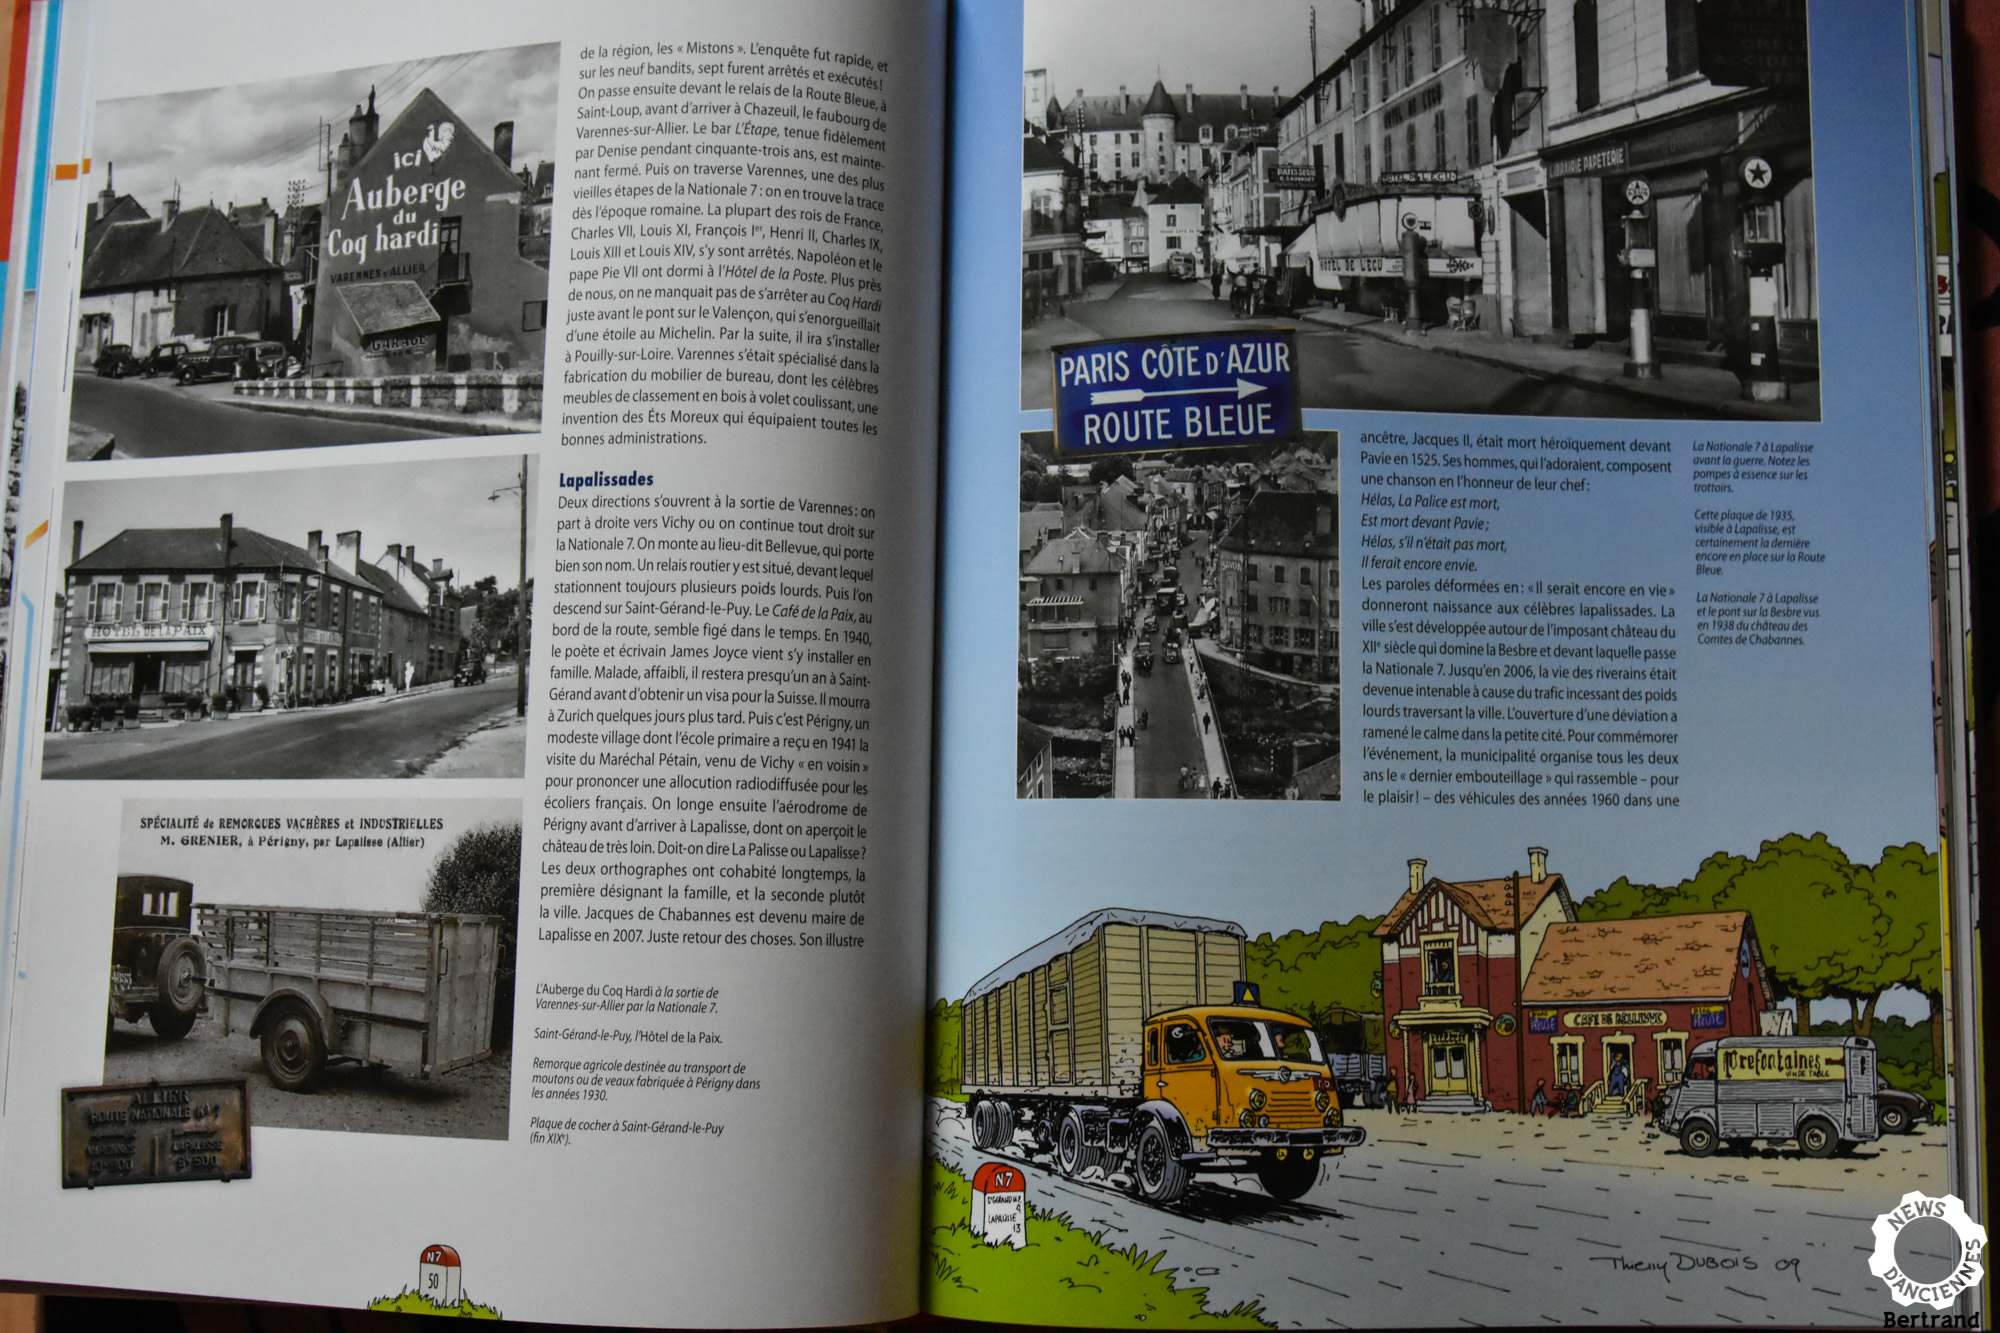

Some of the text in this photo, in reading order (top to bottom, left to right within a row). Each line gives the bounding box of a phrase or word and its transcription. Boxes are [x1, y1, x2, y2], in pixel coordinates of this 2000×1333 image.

[580, 47, 595, 60] de
[598, 45, 608, 58] la
[612, 44, 653, 60] région,
[657, 42, 673, 55] les
[686, 41, 734, 54] Mistons
[750, 42, 810, 60] L'enquête
[813, 46, 831, 62] fut
[834, 53, 874, 71] rapide,
[877, 61, 889, 74] et
[393, 150, 423, 169] ici
[1583, 147, 1624, 171] PAPETERIE
[341, 174, 467, 220] Auberge
[393, 208, 417, 225] du
[328, 220, 439, 264] Coq hardi
[1320, 257, 1341, 272] HOTEL
[1344, 257, 1355, 272] DE
[330, 269, 381, 284] VARENNES
[371, 336, 427, 352] GARAGE
[1060, 342, 1291, 388] PARIS CÔTE D'AZUR
[1084, 402, 1276, 446] ROUTE BLEUE
[1360, 431, 1671, 454] ancêtre, Jacques II, était mort héroïquement devant
[1692, 440, 1814, 455] La Nationale 7 à Lapalisse
[558, 471, 655, 491] Lapalissades
[558, 496, 588, 509] Deux
[591, 494, 651, 509] directions
[654, 494, 711, 508] s'ouvrent
[714, 496, 721, 508] à
[725, 496, 736, 509] la
[740, 497, 775, 511] sortie
[779, 498, 795, 512] de
[860, 507, 876, 519] on
[1361, 493, 1500, 512] Hélas, La Palice est mort,
[1361, 514, 1378, 527] Est
[1380, 516, 1409, 528] mort
[1411, 515, 1452, 530] devant
[1361, 535, 1507, 554] Hélas, s'il n'était pas mort,
[1361, 555, 1478, 572] Il ferait encore envie.
[144, 626, 155, 637] DE
[1697, 633, 1806, 646] Comtes de Chabannes.
[140, 815, 443, 830] SPÉCIALITÉ de REMORQUES VACHÈRES et INDUSTRIELLES
[160, 835, 175, 846] M.
[181, 835, 242, 848] GRENIER,
[247, 837, 254, 846] à
[258, 836, 309, 848] Périgny,
[313, 838, 331, 849] par
[387, 837, 425, 849] (Allier)
[535, 982, 719, 1000] L'Auberge du Coq Hardi à la sortie de
[536, 998, 718, 1016] Varennes-sur-Allier par la Nationale 7.
[534, 1027, 723, 1044] Saint-Gérand-le-Puy, l'Hôtel de la Paix.
[1809, 1069, 1830, 1078] TABLE
[133, 1090, 189, 1105] ALLIER
[90, 1110, 127, 1125] ROUTE
[130, 1106, 192, 1122] NATIONALE
[172, 1140, 223, 1151] LAPALISSE
[995, 1171, 1014, 1188] N7
[1012, 1223, 1021, 1234] 13
[426, 1250, 442, 1263] N7
[1669, 1252, 1758, 1271] DUBOIS
[1774, 1258, 1801, 1283] 09
[428, 1272, 439, 1289] 50
